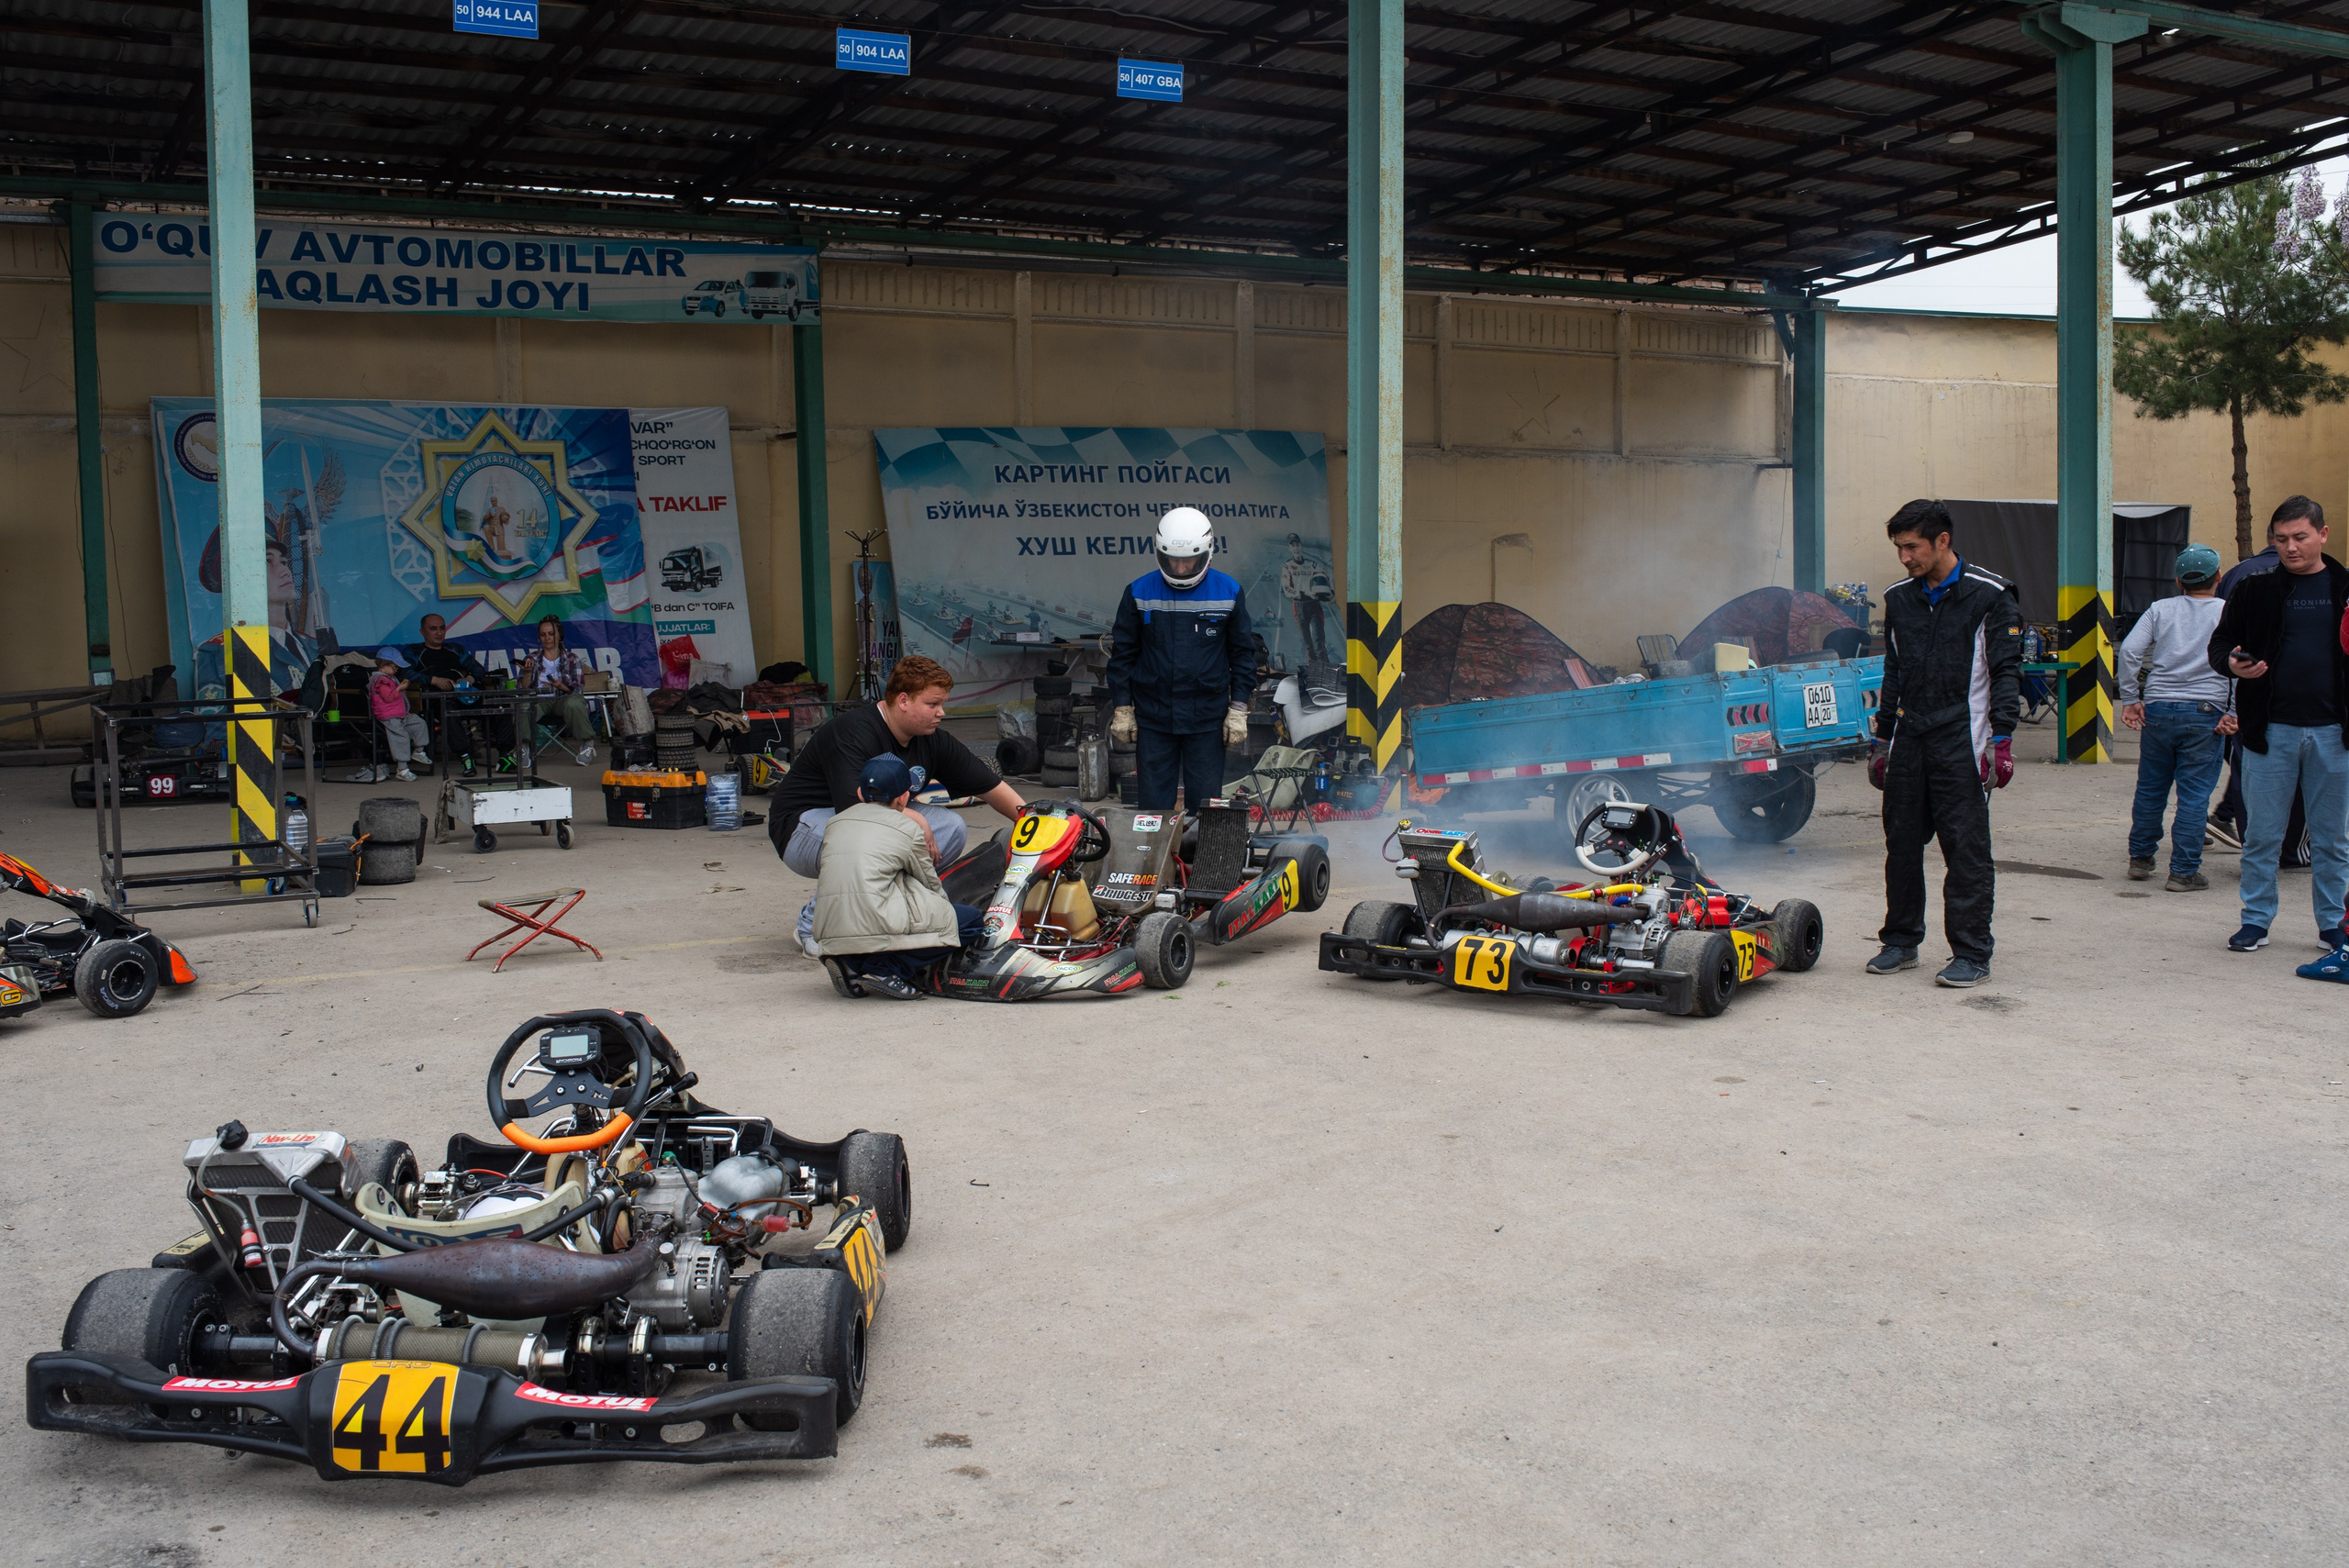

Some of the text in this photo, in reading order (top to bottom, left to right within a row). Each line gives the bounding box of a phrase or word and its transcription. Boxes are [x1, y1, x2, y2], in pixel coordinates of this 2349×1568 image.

[456, 5, 534, 23] 50 944 LAA
[838, 44, 907, 61] 50 904 LAA
[1119, 72, 1182, 88] 50 407 GBA
[290, 231, 687, 276] AVTOMOBILLAR
[257, 269, 589, 311] AQLASH JOYI
[639, 455, 685, 465] SPORT
[446, 455, 551, 497] VATAN HIMOYACHILARI KUNI
[995, 460, 1230, 484] КАРТИНГ ПОЙГАСИ
[649, 496, 727, 512] TAKLIF
[927, 499, 1290, 519] БЎЙИЧА ЎЗБЕКИСТОН ЧЕИОНАТИГА
[517, 508, 539, 529] 14
[1017, 537, 1076, 555] ХУШ
[1172, 539, 1193, 548] agv
[664, 604, 685, 612] dan
[702, 602, 735, 611] TOIFA
[1809, 686, 1831, 705] 0610
[1809, 707, 1831, 724] AA 20
[756, 759, 761, 783] 9
[150, 777, 173, 795] 99
[1016, 816, 1040, 848] 9
[1282, 872, 1291, 910] 9
[987, 906, 1012, 915] MOTUL
[1229, 876, 1279, 938] ITALKART
[1464, 939, 1506, 984] 73
[1739, 942, 1754, 979] 73
[949, 977, 989, 986] ITALKART
[1104, 962, 1137, 986] ITALKART
[100, 986, 119, 1009] VEGA
[372, 1360, 431, 1369] CRG
[172, 1375, 297, 1390] MOTUL
[524, 1386, 648, 1407] MOTUL
[333, 1373, 451, 1472] 44
